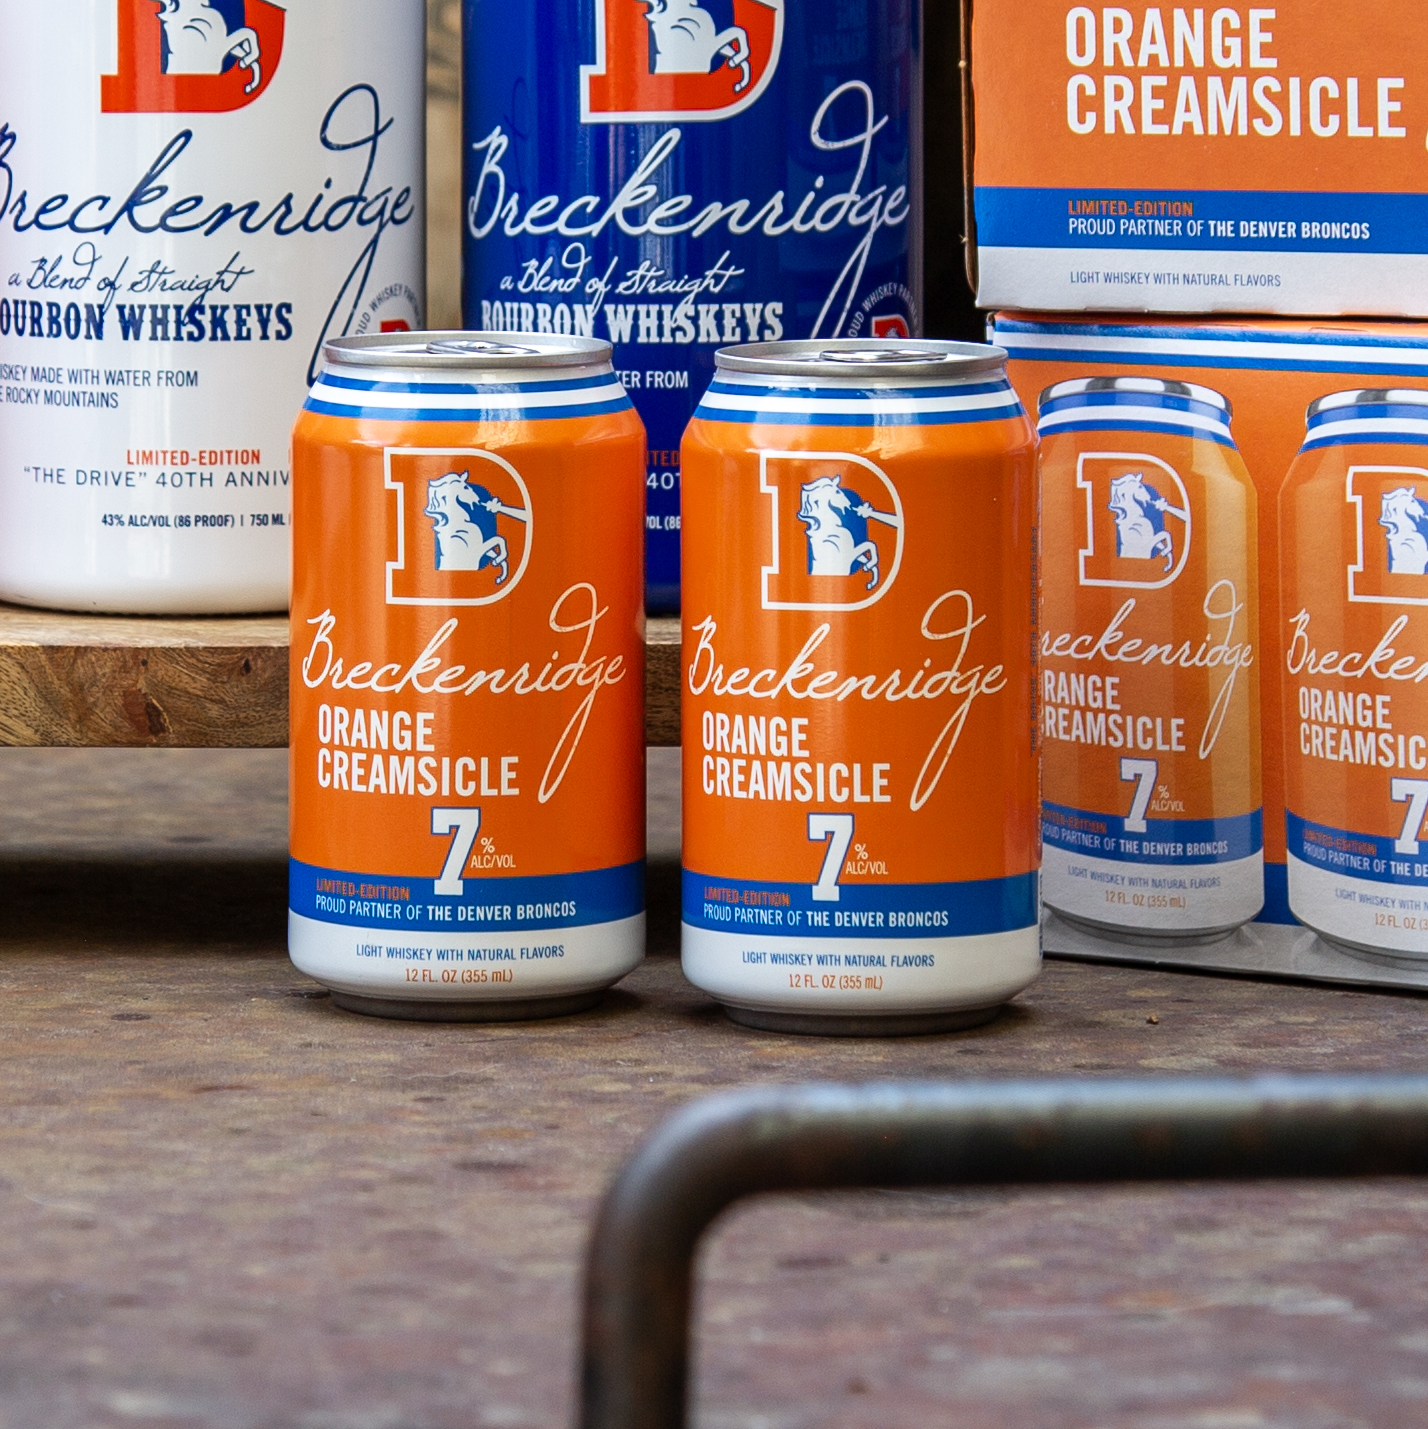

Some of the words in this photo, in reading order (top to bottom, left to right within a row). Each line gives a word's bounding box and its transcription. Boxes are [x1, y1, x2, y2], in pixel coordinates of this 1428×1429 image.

[1065, 6, 1278, 68] ORANGE
[1066, 73, 1406, 137] CREAMSICLE
[470, 80, 910, 339] Breckenridge
[1068, 199, 1194, 217] LIMITED-EDITION
[1068, 218, 1115, 236] PROUD
[1120, 219, 1182, 237] PARTNER
[1187, 220, 1204, 237] OF
[1208, 220, 1235, 238] THE
[1239, 221, 1297, 239] DENVER
[1301, 222, 1371, 240] BRONCOS
[8, 272, 22, 287] a
[27, 241, 102, 290] Blend
[97, 256, 129, 316] of
[127, 251, 255, 326] Straight
[500, 275, 514, 290] a
[517, 242, 592, 293] Blend
[585, 256, 618, 318] of
[617, 250, 745, 327] Straight
[1070, 271, 1100, 284] LIGHT
[1102, 271, 1150, 286] WHISKEY
[1153, 272, 1180, 286] WITH
[1182, 273, 1231, 287] NATURAL
[1233, 273, 1282, 287] FLAVORS
[116, 302, 293, 343] WHISKEYS
[481, 300, 595, 337] BOURBON
[605, 302, 784, 344] WHISKEYS
[30, 365, 63, 384] MADE
[66, 367, 100, 386] WITH
[103, 369, 151, 387] WATER
[156, 370, 199, 387] FROM
[645, 370, 689, 389] FROM
[5, 386, 40, 405] ROCKY
[43, 389, 118, 408] MOUNTAINS
[126, 448, 261, 466] LIMITED-EDITION
[155, 471, 213, 489] 40TH
[101, 514, 125, 527] 43%
[128, 514, 171, 528] ALC/VOL
[173, 514, 191, 529] (86
[194, 514, 235, 528] PROOF)
[250, 514, 269, 527] 750
[271, 514, 285, 526] ML
[1040, 579, 1255, 759] reckenridge
[302, 582, 627, 803] Breckenridge
[689, 590, 1008, 812] Breckenridge
[1044, 669, 1121, 711] RANGE
[1299, 685, 1392, 730] ORANGE
[318, 703, 435, 752] ORANGE
[702, 710, 810, 758] ORANGE
[1044, 706, 1186, 752] REAMSICLE
[318, 748, 520, 797] CREAMSICLE
[702, 755, 892, 803] CREAMSICLE
[430, 806, 481, 896] 7
[470, 854, 516, 869] ALC/VOL
[807, 812, 855, 902] 7
[845, 861, 888, 875] ALC/VOL
[315, 894, 346, 914] PROUD
[349, 900, 402, 920] PARTNER
[406, 904, 423, 921] OF
[427, 905, 452, 921] THE
[457, 904, 511, 922] DENVER
[516, 900, 577, 920] BRONCOS
[316, 877, 410, 901] LIMITED-EDITION
[704, 886, 791, 907] LIMITED-EDITION
[703, 903, 732, 922] PROUD
[734, 907, 783, 926] PARTNER
[787, 910, 803, 926] OF
[806, 910, 830, 927] THE
[835, 911, 884, 927] DENVER
[888, 910, 949, 927] BRONCOS
[356, 944, 383, 958] LIGHT
[386, 946, 433, 961] WHISKEY
[436, 948, 463, 961] WITH
[467, 948, 516, 961] NATURAL
[520, 945, 565, 960] FLAVORS
[742, 950, 767, 964] LIGHT
[770, 953, 813, 966] WHISKEY
[816, 954, 841, 967] WITH
[844, 954, 887, 967] NATURAL
[890, 954, 935, 967] FLAVORS
[405, 968, 418, 982] 12
[422, 969, 438, 983] FL.
[441, 969, 457, 983] OZ
[461, 969, 488, 984] (355
[491, 969, 513, 983] mL)
